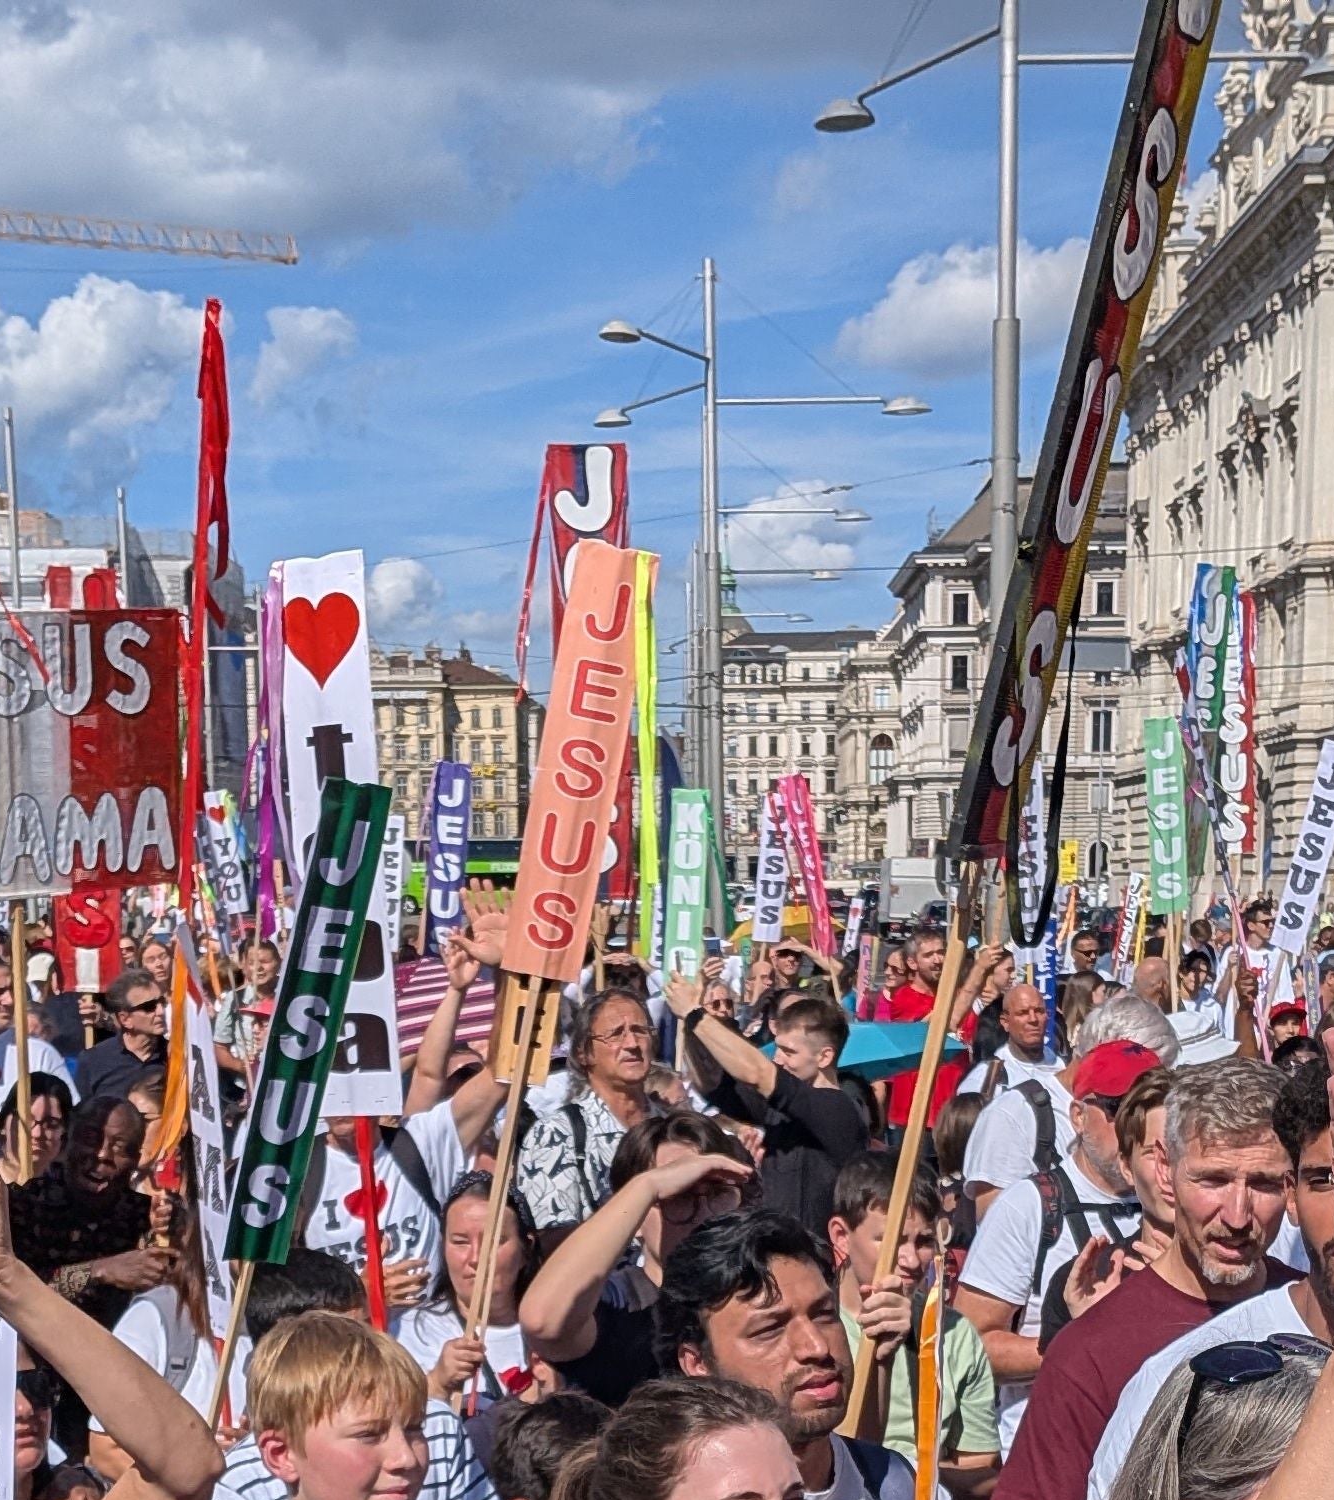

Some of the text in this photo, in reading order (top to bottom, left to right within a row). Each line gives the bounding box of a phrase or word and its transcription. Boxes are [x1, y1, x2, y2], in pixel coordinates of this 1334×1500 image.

[0, 786, 176, 885] AMA
[529, 584, 632, 950] JESUS
[1152, 732, 1183, 899] JESUS
[215, 837, 244, 902] YOU
[671, 802, 706, 980] KÖNIG
[760, 805, 787, 925] JESUS
[241, 820, 371, 1228] JESUS
[322, 1199, 341, 1231] I
